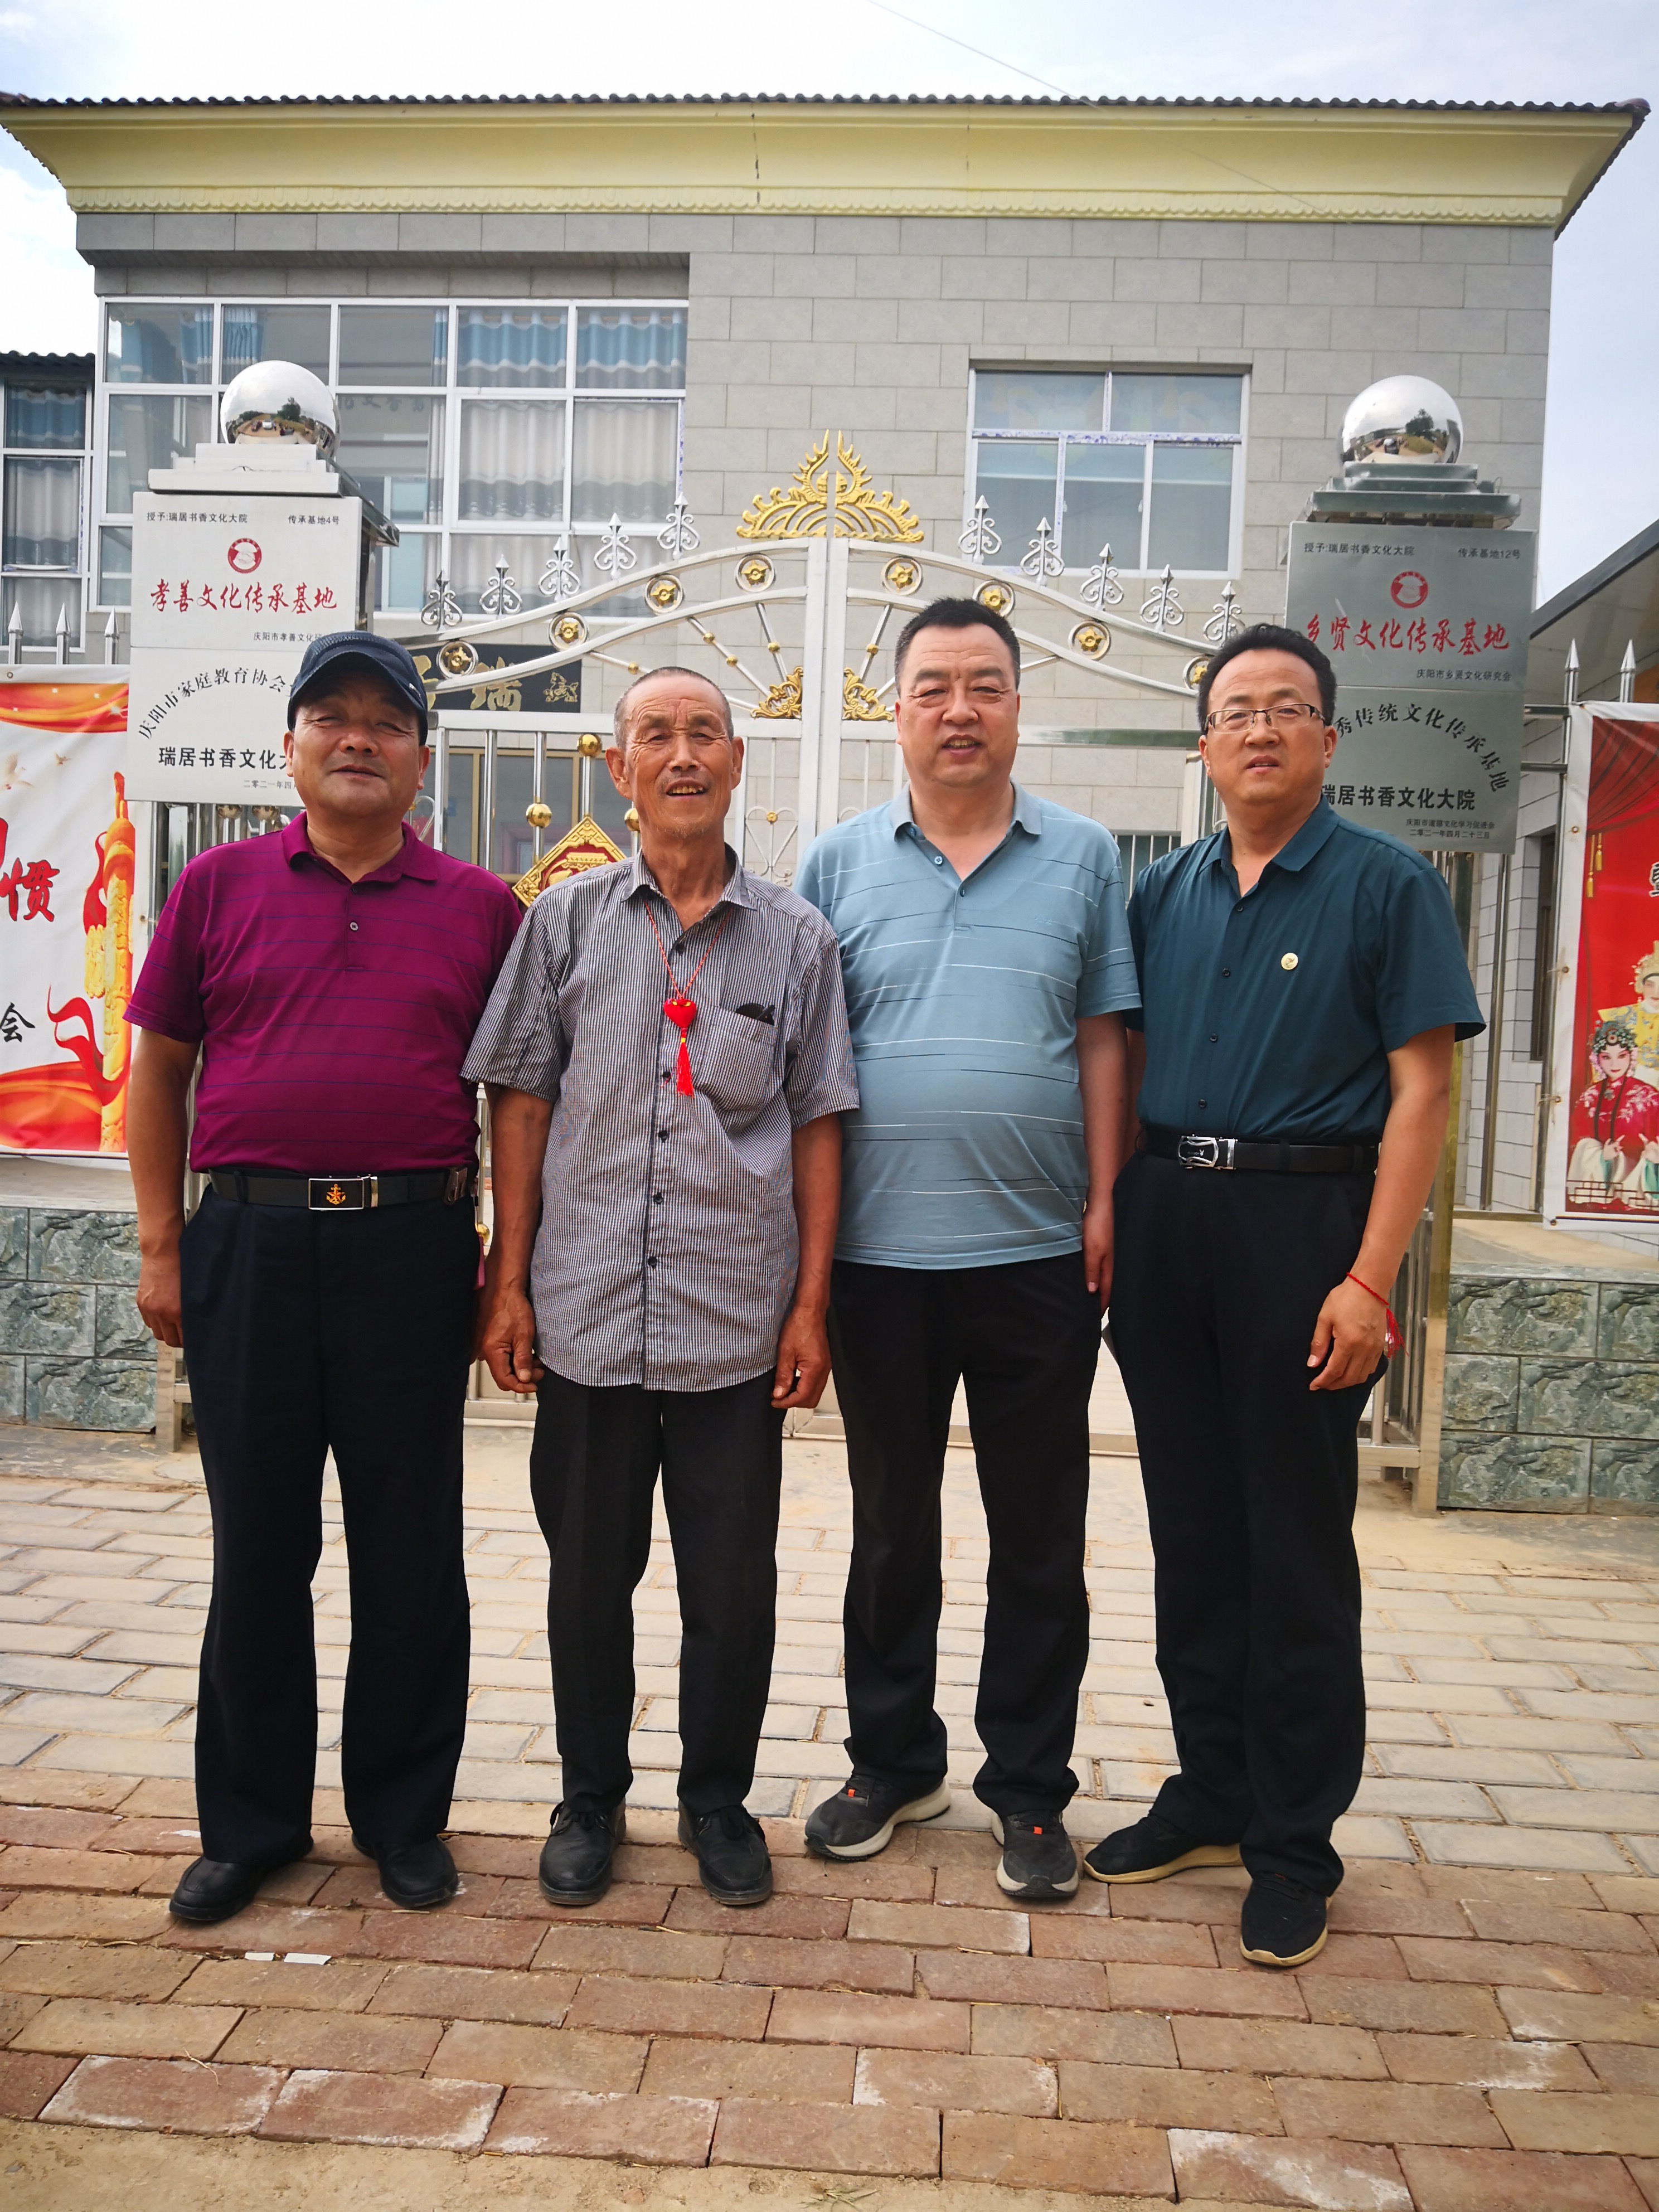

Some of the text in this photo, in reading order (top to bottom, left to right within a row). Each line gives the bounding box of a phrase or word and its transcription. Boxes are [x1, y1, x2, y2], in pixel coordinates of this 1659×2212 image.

[288, 515, 339, 525] 传承基地4号
[1458, 548, 1521, 560] 传承基地12号
[151, 578, 337, 614] 孝善文化传承基地
[1307, 614, 1509, 656] 乡贤文化传承基地
[1417, 669, 1512, 682] 庆阳市乡贤文化研究会
[138, 667, 293, 740] 庆阳市家庭教育协会
[244, 779, 296, 790] 二零二一年四
[1410, 828, 1490, 839] 二零二一年四月二十三日
